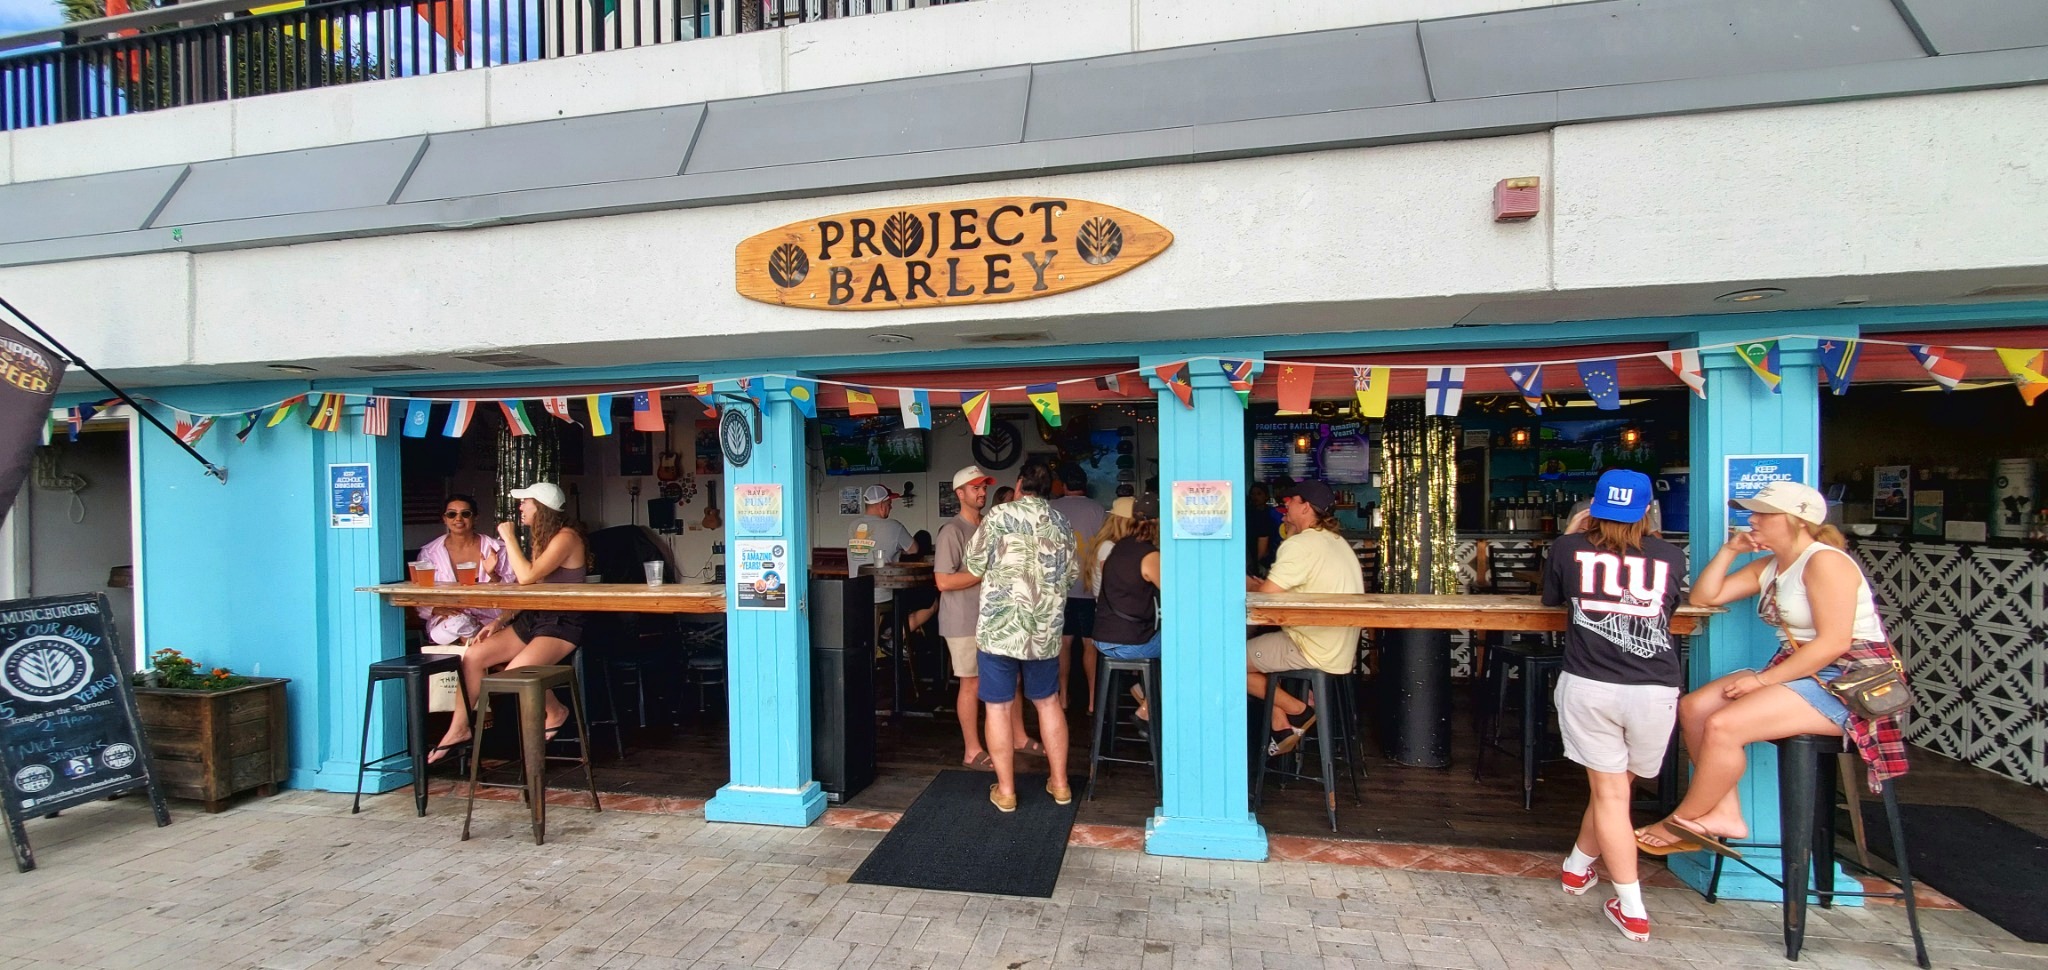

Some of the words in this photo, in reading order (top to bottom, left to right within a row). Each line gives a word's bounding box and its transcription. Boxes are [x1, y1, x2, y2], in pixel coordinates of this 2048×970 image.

[818, 200, 1068, 260] PROJECT
[828, 249, 1058, 305] BARLEY
[1255, 423, 1288, 431] PROJECT
[1330, 421, 1361, 432] Amazing
[1332, 428, 1356, 438] Years!
[1755, 465, 1778, 474] KEEP
[1740, 473, 1792, 482] ALCOHOLIC
[1607, 486, 1633, 506] ny
[742, 552, 746, 561] 5
[747, 552, 773, 561] AMAZING
[742, 561, 761, 570] YEARS!
[1574, 550, 1670, 618] ny
[25, 622, 60, 636] OUR
[8, 712, 43, 726] Tonight
[45, 710, 55, 718] in
[56, 707, 71, 715] the
[72, 698, 115, 712] Taproom:
